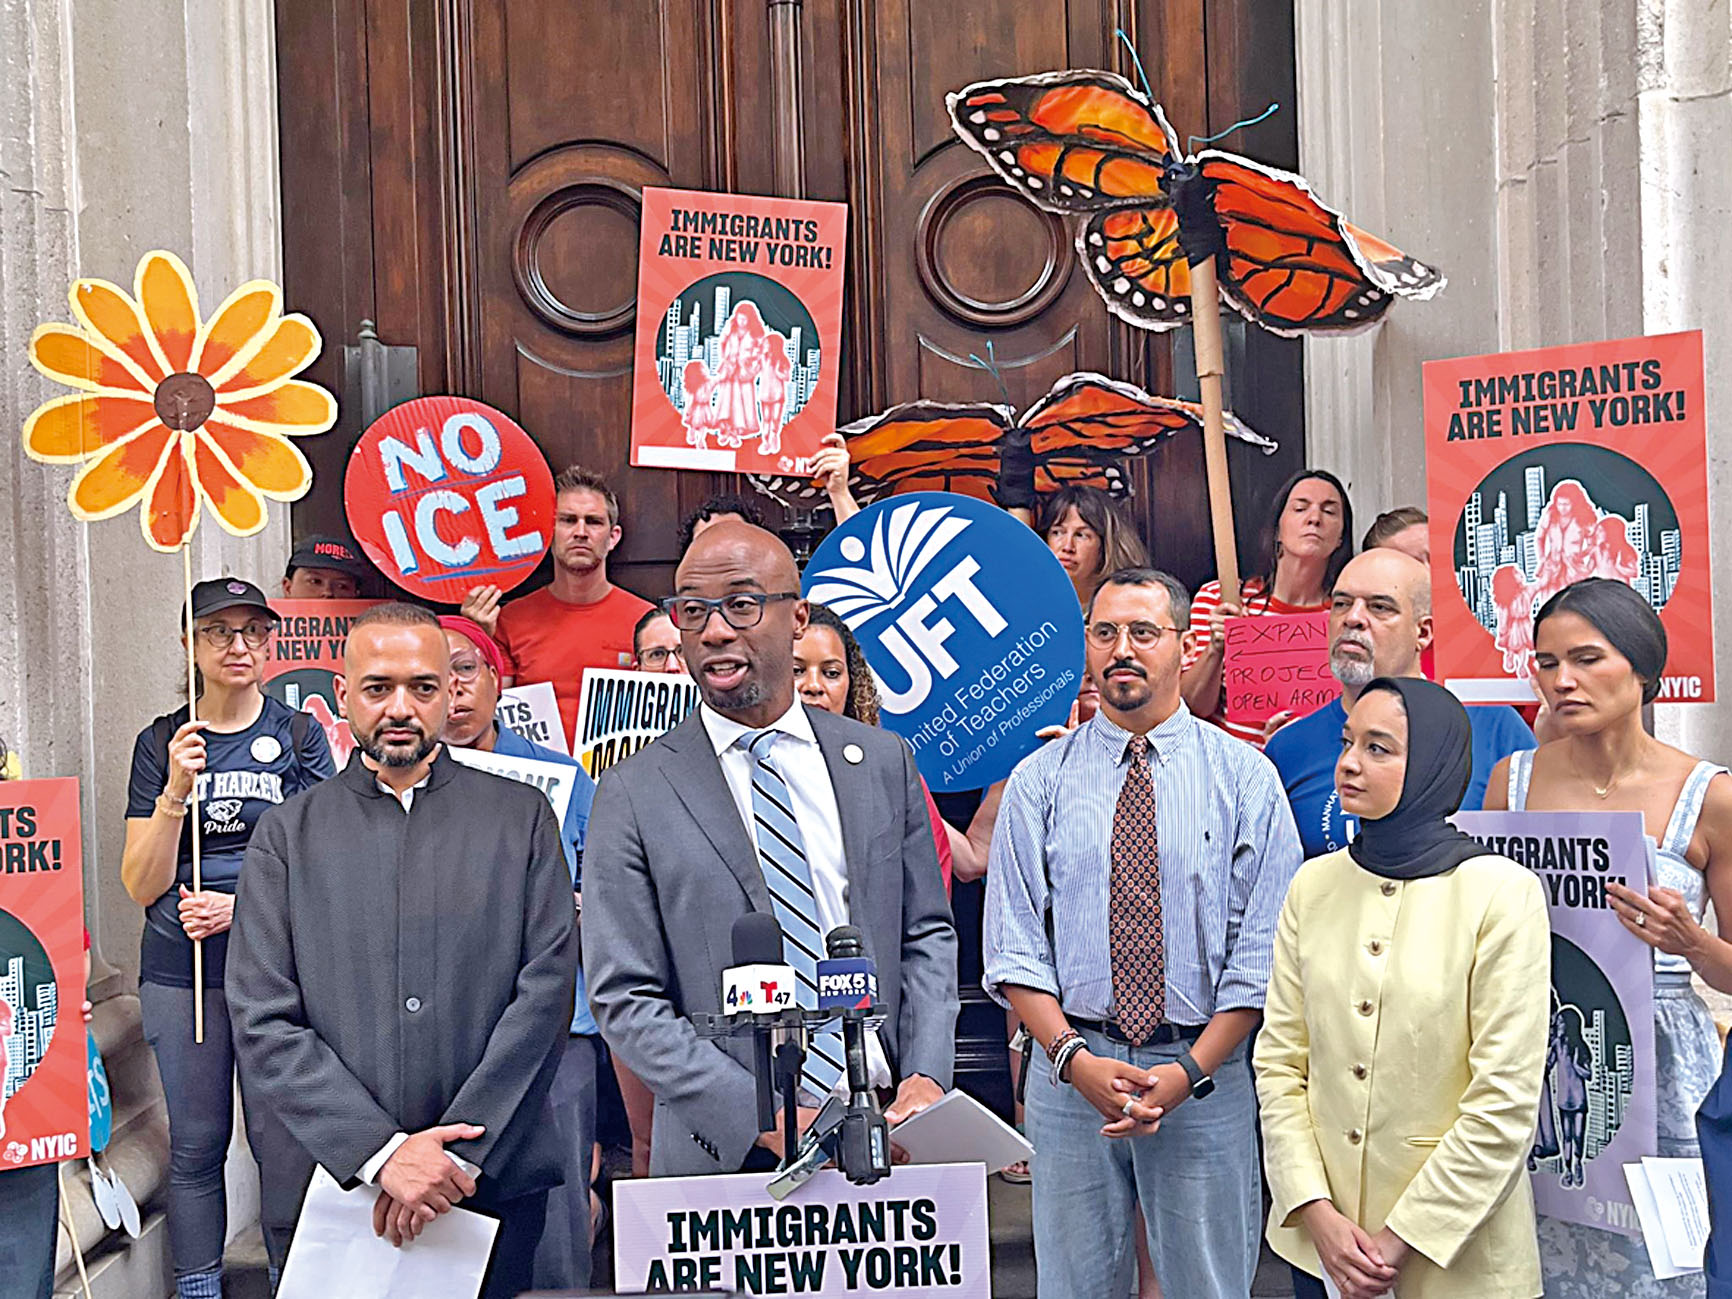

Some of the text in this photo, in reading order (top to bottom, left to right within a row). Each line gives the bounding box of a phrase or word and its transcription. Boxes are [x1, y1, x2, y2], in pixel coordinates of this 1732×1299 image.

[671, 209, 818, 242] IMMIGRANTS
[658, 234, 832, 269] ARE NEW YORK!
[1459, 360, 1661, 408] IMMIGRANTS
[1447, 391, 1686, 442] ARE NEW YORK!
[378, 412, 501, 494] NO
[382, 475, 544, 575] ICE
[277, 640, 321, 660] NEW
[867, 554, 1008, 714] UFT
[954, 621, 1058, 709] Federation
[1658, 676, 1701, 698] NYIC
[939, 663, 1046, 756] of Teachers
[1232, 692, 1278, 710] OPEN
[942, 669, 1075, 785] A Union of Professionals
[203, 819, 246, 835] Pride
[726, 984, 738, 1007] 4
[774, 992, 791, 1005] 47
[31, 1133, 77, 1161] NYIC
[667, 1199, 937, 1253] IMMIGRANTS
[735, 1250, 827, 1295] NEW
[838, 1244, 961, 1290] YORK!
